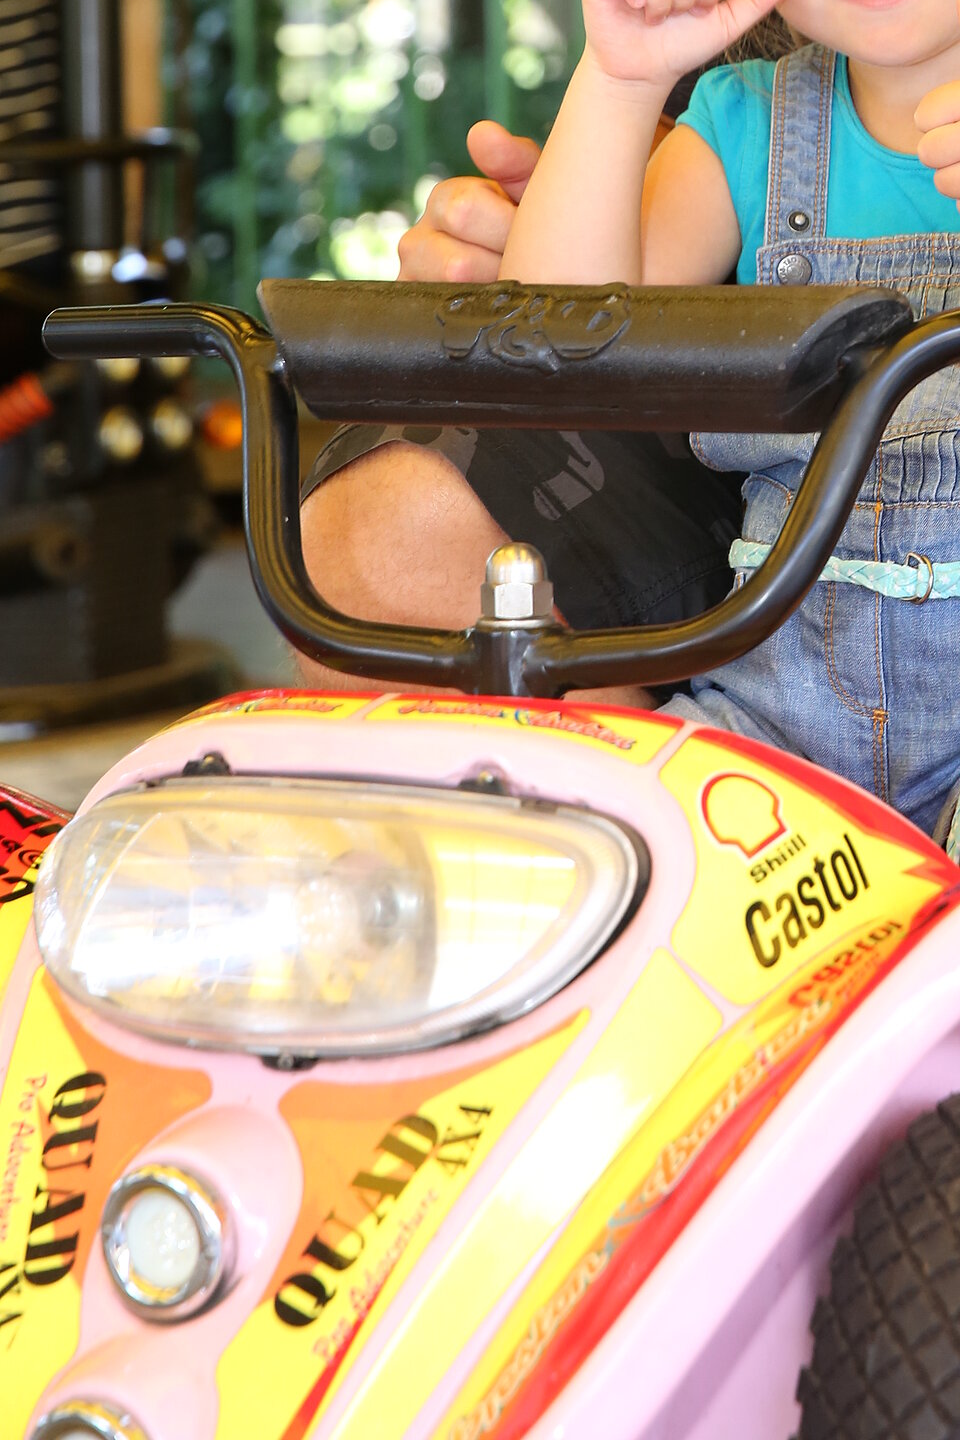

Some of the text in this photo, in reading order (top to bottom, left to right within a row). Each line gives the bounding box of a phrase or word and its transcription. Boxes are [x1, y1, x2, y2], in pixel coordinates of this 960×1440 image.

[745, 833, 869, 969] Castol
[750, 834, 807, 883] Shiill
[24, 1071, 107, 1286] QUAD
[433, 1104, 493, 1177] 4X4
[273, 1113, 439, 1328] QUAD
